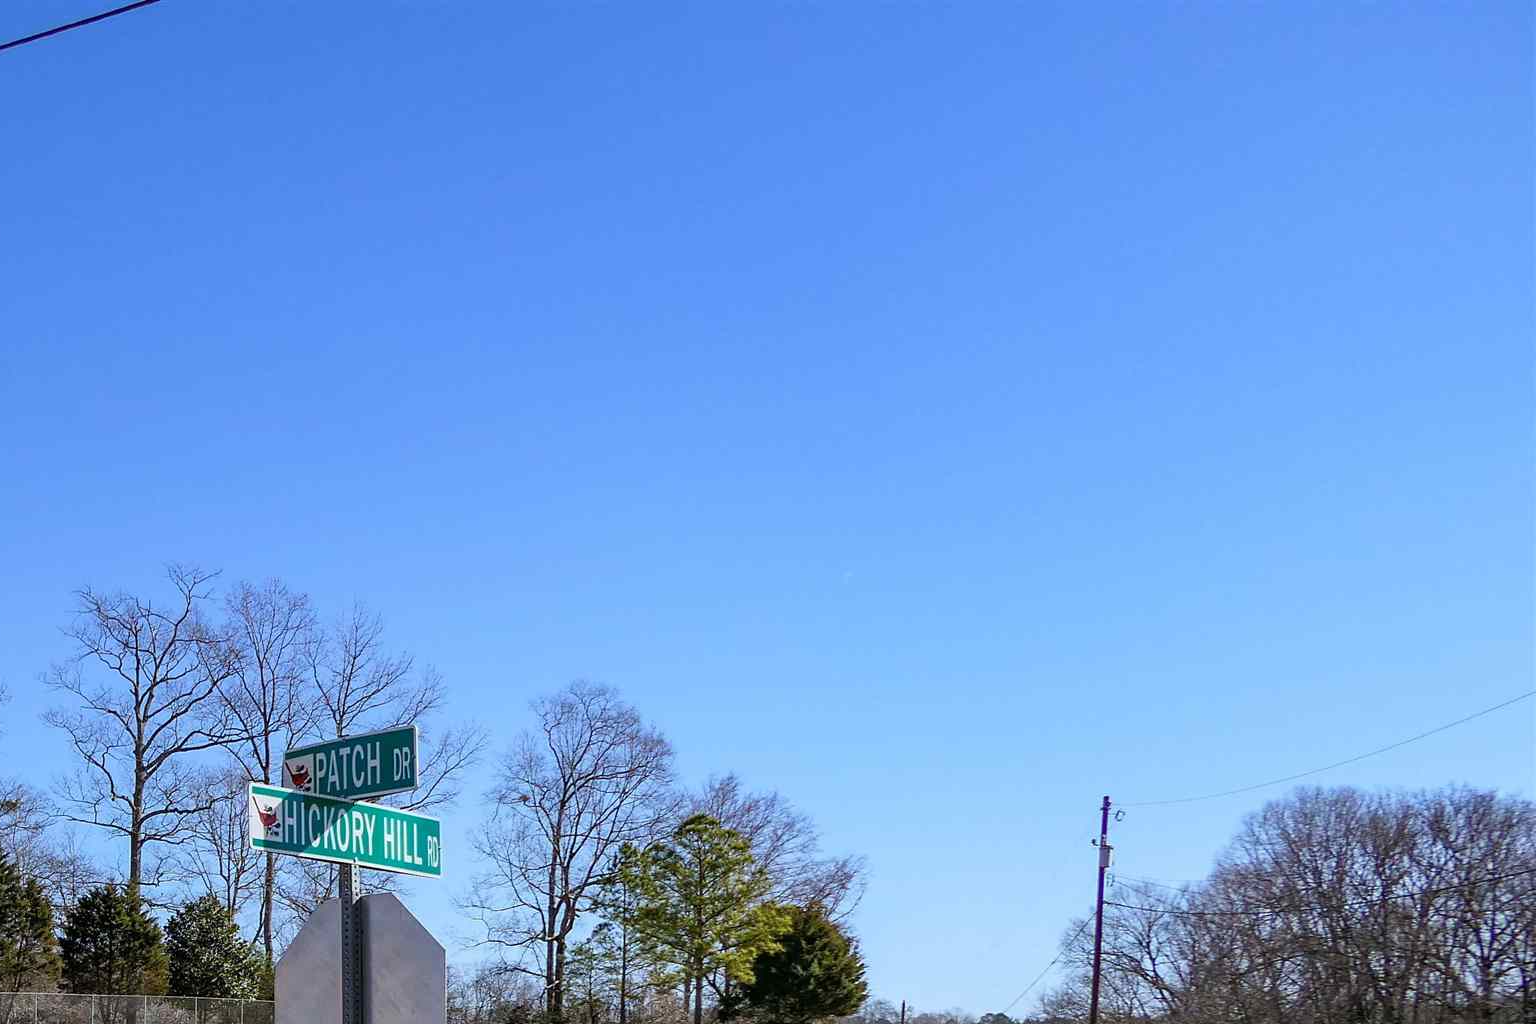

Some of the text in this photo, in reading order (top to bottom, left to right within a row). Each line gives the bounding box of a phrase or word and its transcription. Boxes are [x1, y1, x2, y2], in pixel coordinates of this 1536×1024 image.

[316, 742, 411, 796] PATCH DR
[285, 800, 439, 867] HICKORY HILL RD
